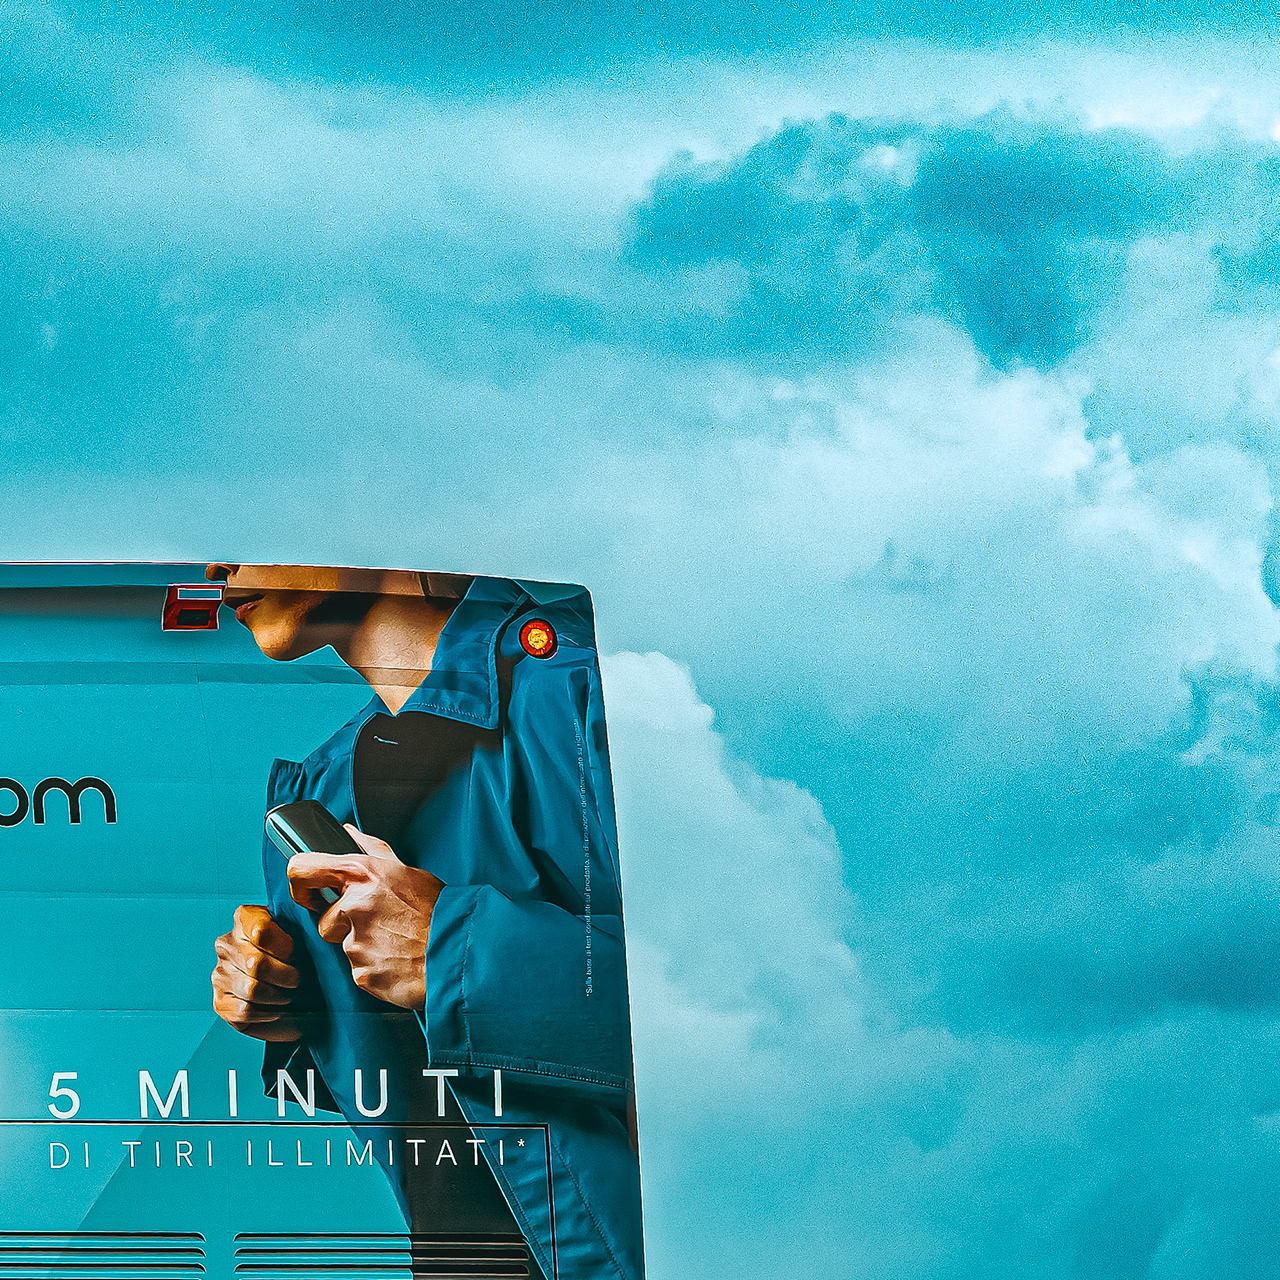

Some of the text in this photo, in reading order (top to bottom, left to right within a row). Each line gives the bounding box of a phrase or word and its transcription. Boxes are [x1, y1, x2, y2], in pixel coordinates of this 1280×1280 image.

[48, 1069, 506, 1118] 5 MINUTI
[49, 1141, 91, 1169] DI
[122, 1139, 215, 1167] TIRI
